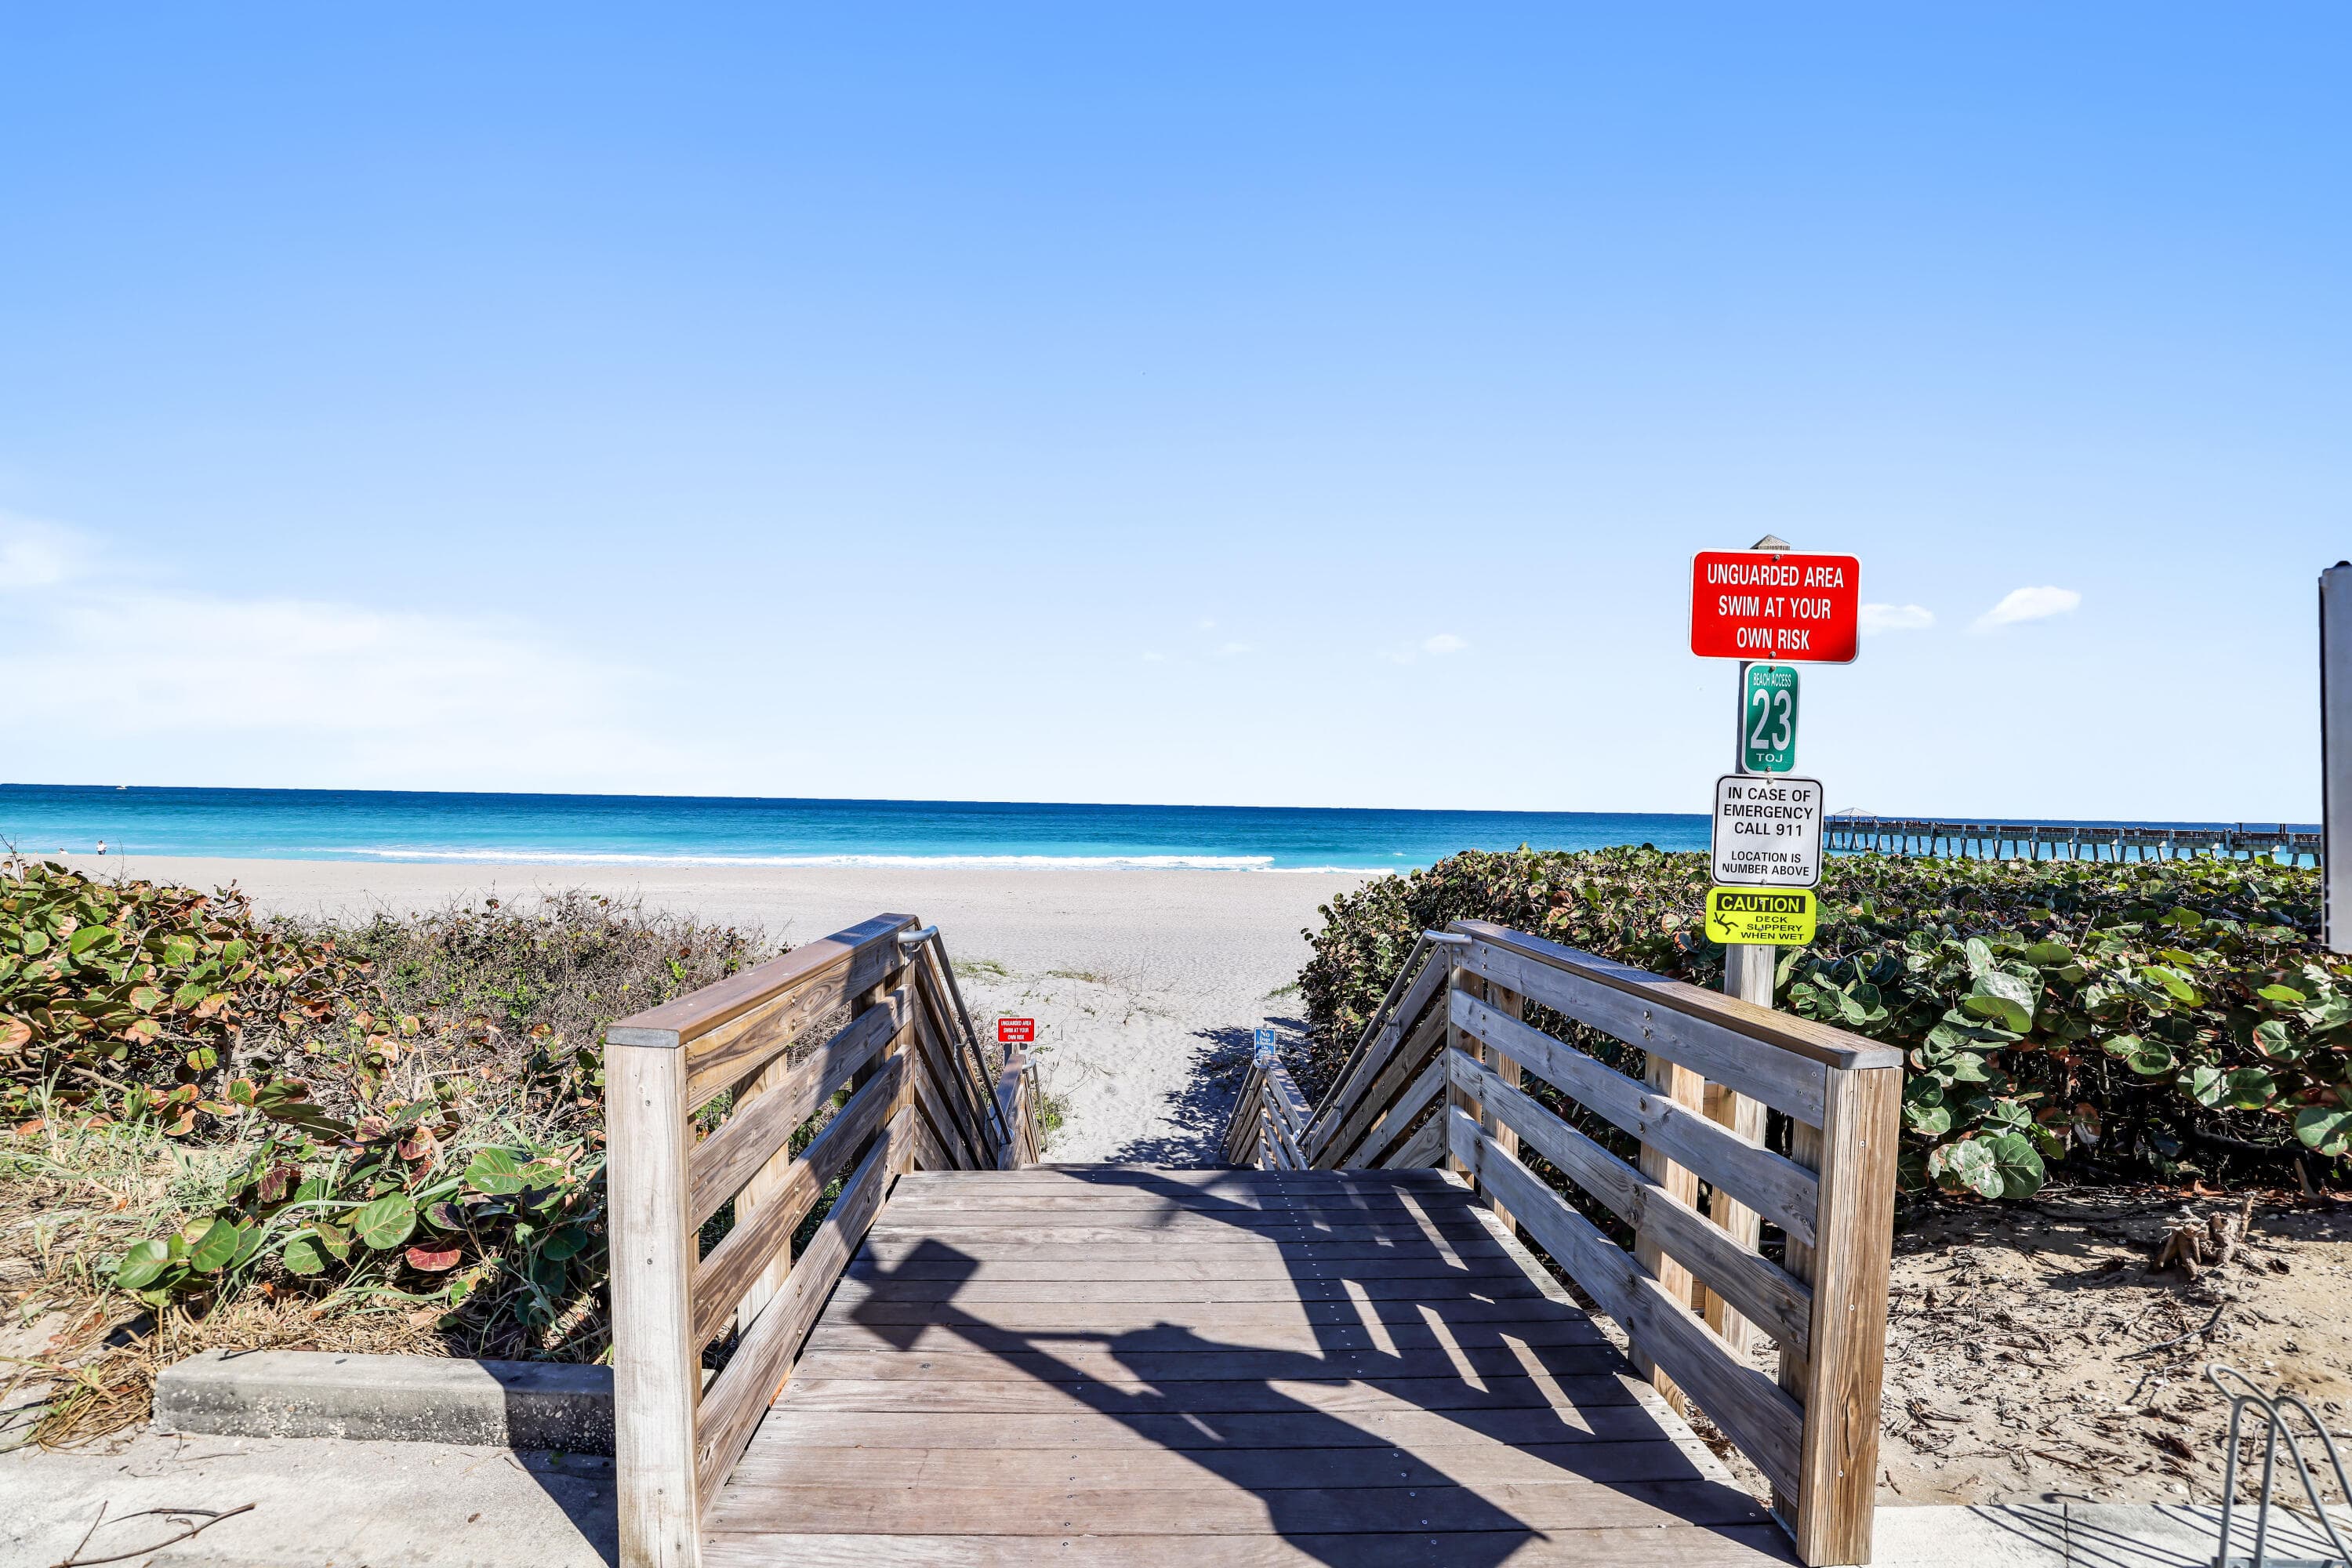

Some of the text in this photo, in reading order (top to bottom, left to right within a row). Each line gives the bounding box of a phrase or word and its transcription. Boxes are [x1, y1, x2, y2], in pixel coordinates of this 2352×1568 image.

[1708, 564, 1844, 588] UNGUARDED AREA
[1719, 595, 1831, 619] SWIM AT YOUR
[1737, 627, 1810, 650] OWN RISK
[1753, 673, 1791, 688] BEACH ACCESS
[1750, 688, 1792, 751] 23
[1756, 753, 1783, 763] TOJ
[1728, 786, 1811, 802] IN CASE OF
[1724, 804, 1813, 820] EMERGENCY
[1734, 822, 1802, 837] CALL 911
[1731, 851, 1801, 863] LOCATION IS
[1722, 863, 1809, 877] NUMBER ABOVE
[1721, 895, 1799, 913] CAUTION
[1747, 924, 1802, 932] SLIPPERY
